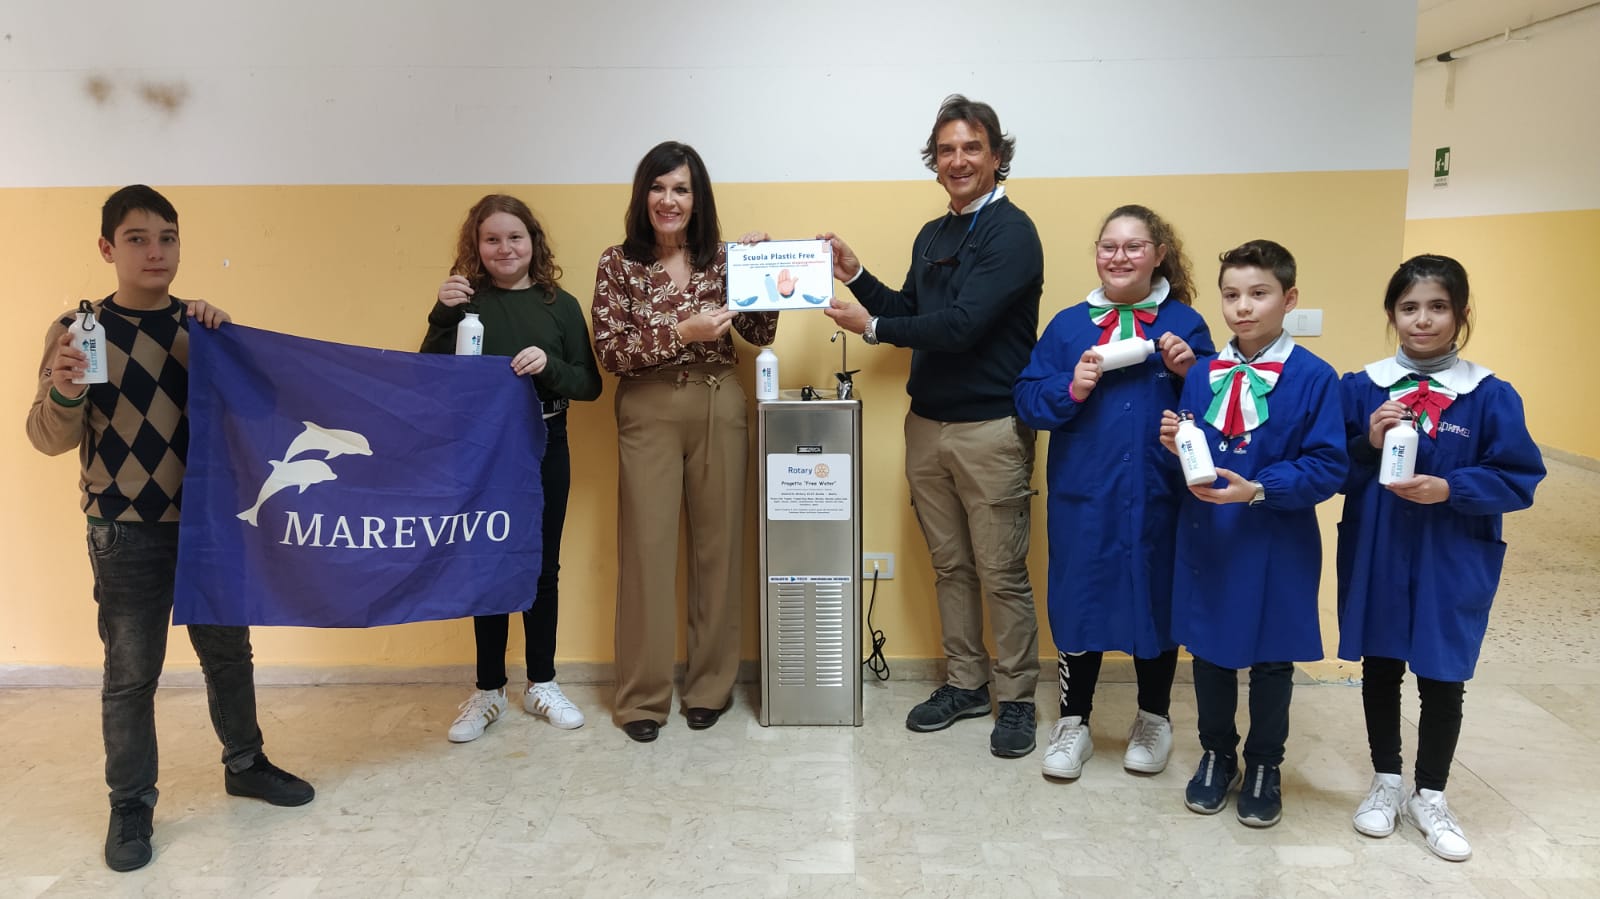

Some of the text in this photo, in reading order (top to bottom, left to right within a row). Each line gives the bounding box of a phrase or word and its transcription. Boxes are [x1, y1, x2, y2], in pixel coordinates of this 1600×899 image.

[770, 252, 796, 260] Plastic
[788, 466, 813, 475] Rotary
[279, 510, 511, 549] MAREVIVO
